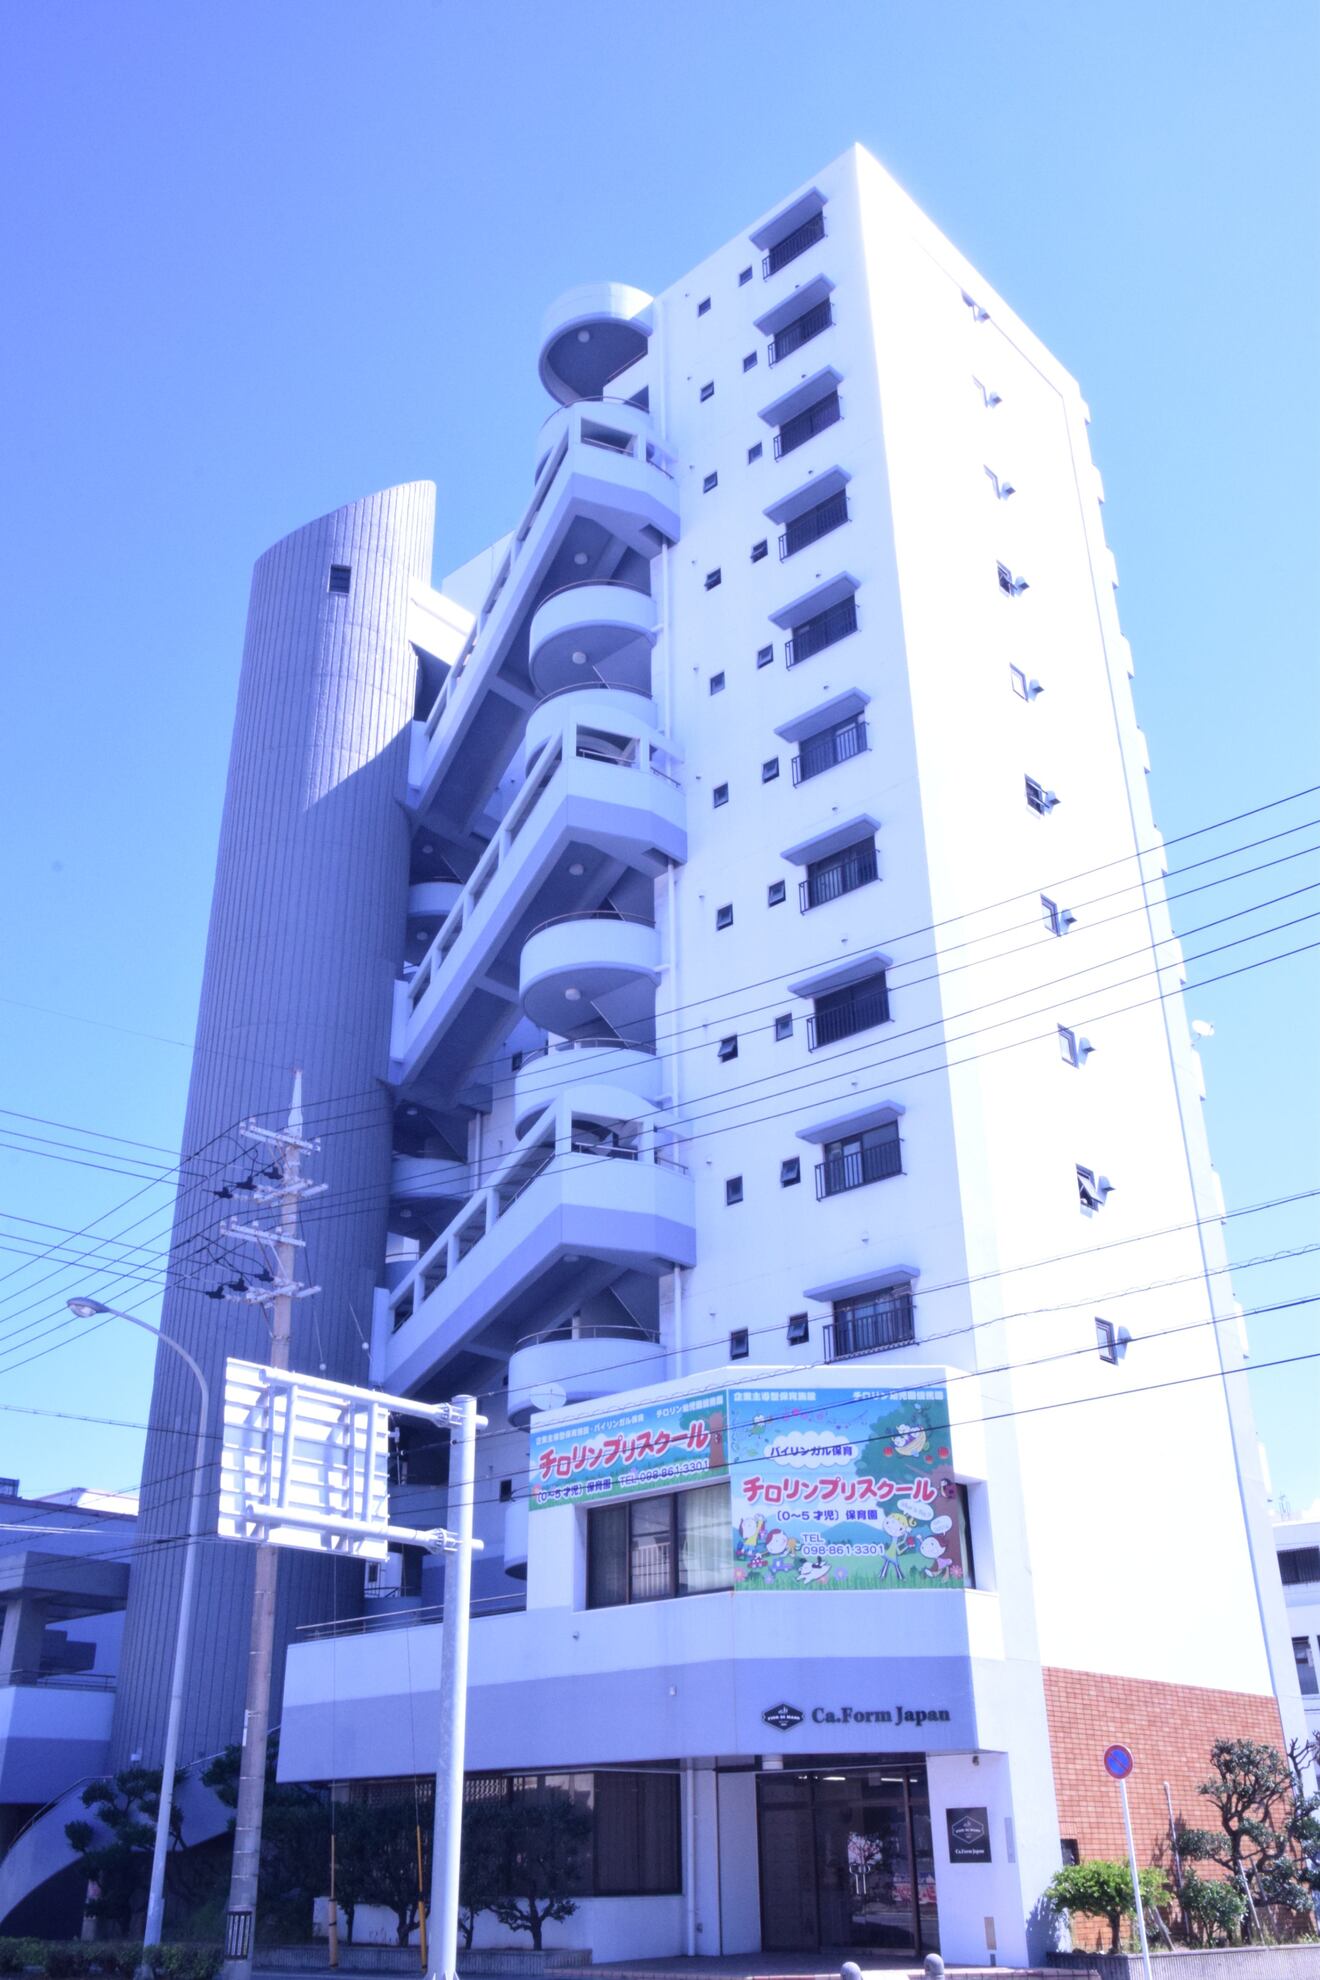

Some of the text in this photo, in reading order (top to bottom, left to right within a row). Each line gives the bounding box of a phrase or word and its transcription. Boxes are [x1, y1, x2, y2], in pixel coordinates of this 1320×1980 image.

[538, 1422, 712, 1480] チロリンプリスクール
[770, 1446, 853, 1457] バイリンガル保育
[743, 1476, 937, 1503] チロリンプリスクール
[846, 1509, 878, 1521] 保育園
[803, 1534, 824, 1543] TEL
[803, 1545, 884, 1555] 098-861-3301
[812, 1707, 951, 1726] Ca.Form Japan
